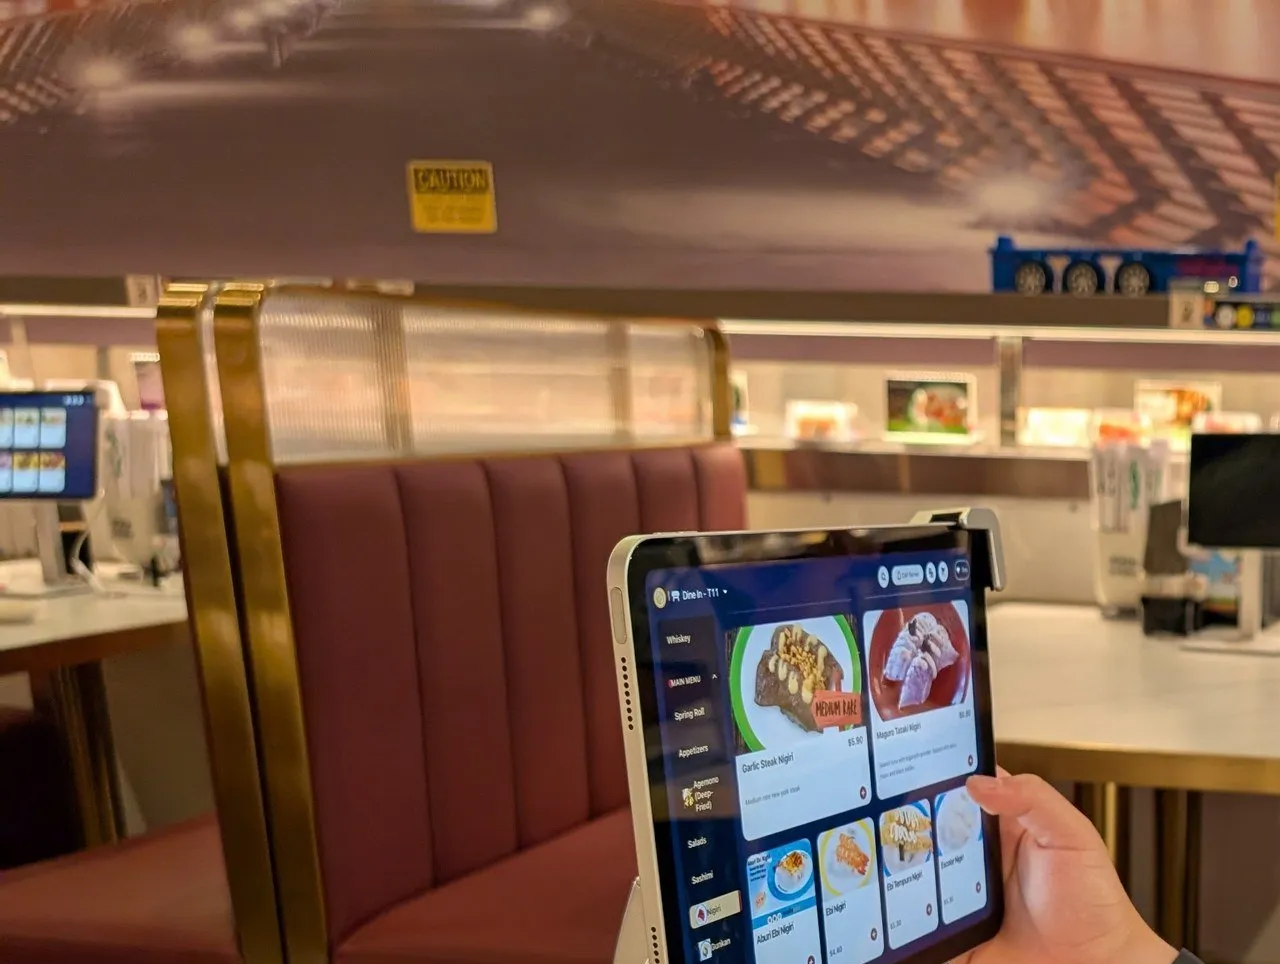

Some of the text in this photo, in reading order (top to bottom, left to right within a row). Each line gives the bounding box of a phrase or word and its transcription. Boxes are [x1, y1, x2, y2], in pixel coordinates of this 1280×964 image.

[418, 169, 487, 189] CAUTION
[682, 589, 696, 600] Dine
[697, 589, 703, 599] In
[707, 587, 719, 598] T11
[666, 634, 691, 645] Whiskey
[672, 675, 701, 687] MAIN MENU
[674, 707, 705, 721] Spring Roll
[815, 698, 857, 717] MEDIUM RARE
[876, 728, 895, 740] Maguro
[909, 722, 922, 733] Nigiri
[679, 745, 709, 758] Appetizers
[742, 752, 794, 774] Garlic Steak Nigiri
[693, 776, 720, 789] Agemono
[694, 790, 714, 801] (Deep-
[695, 801, 713, 812] Fried)
[687, 836, 707, 849] Salads
[691, 869, 714, 885] Sashimi
[886, 871, 923, 892] Ebi Tempura Nigiri
[707, 904, 722, 916] Nigiri
[825, 900, 847, 917] Ebi Nigiri
[756, 922, 795, 944] Aburi Ebi Nigiri
[711, 938, 731, 952] Gunkan
